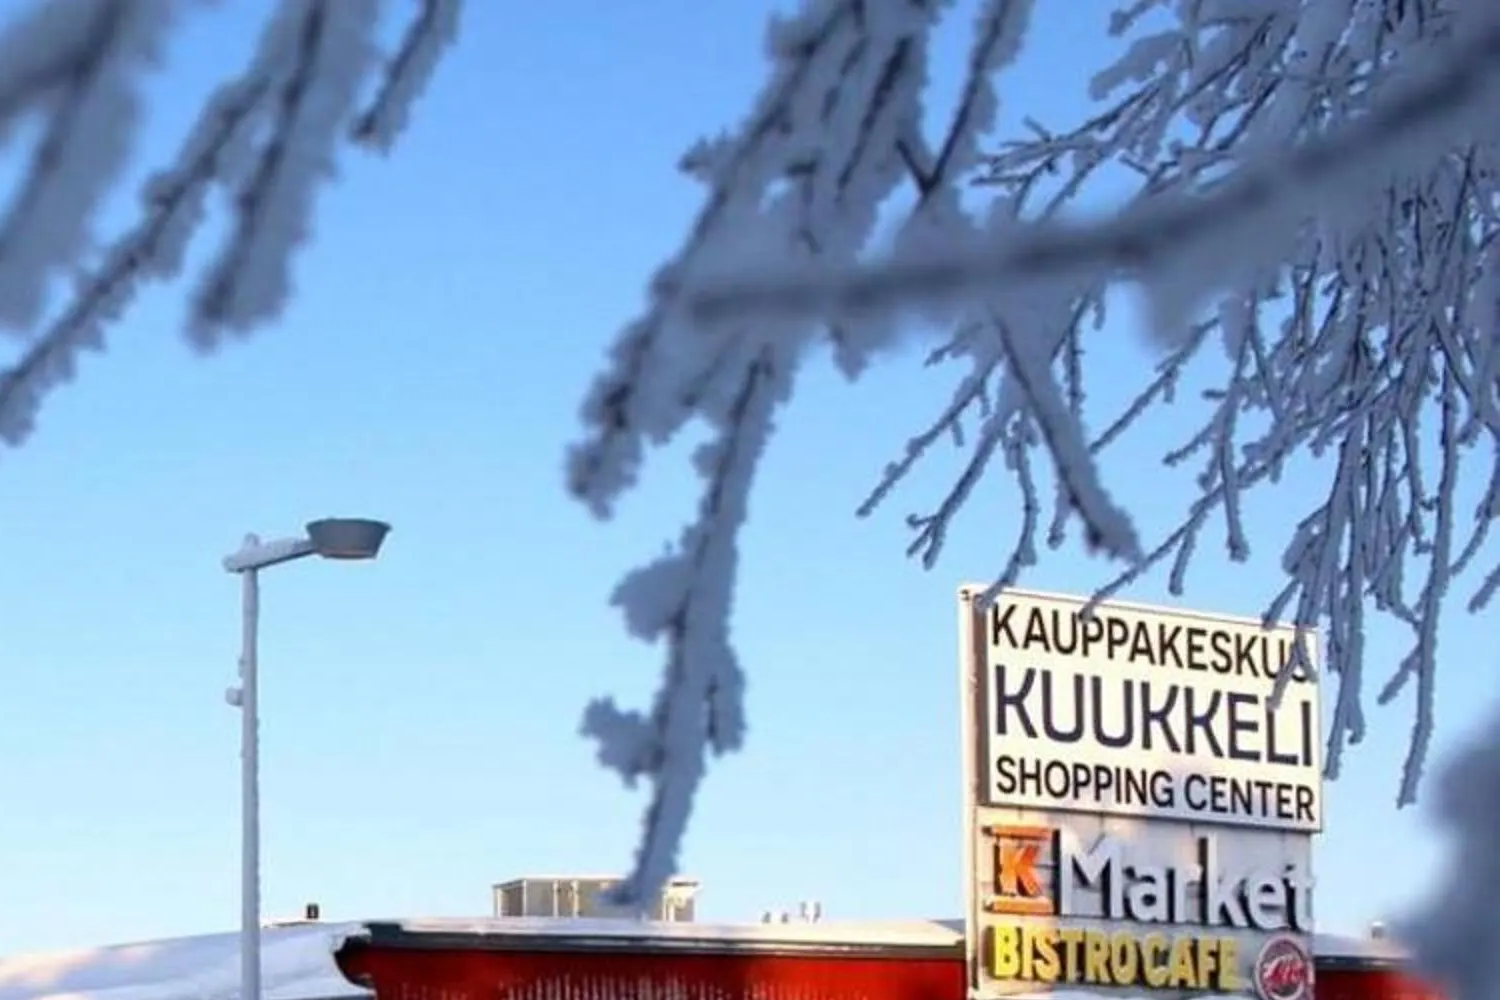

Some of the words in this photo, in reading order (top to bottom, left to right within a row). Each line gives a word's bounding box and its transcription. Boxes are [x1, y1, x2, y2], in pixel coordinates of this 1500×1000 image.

[996, 664, 1313, 767] KUUKKELI
[996, 754, 1176, 808] SHOPPING
[1184, 773, 1315, 822] CENTER
[1060, 828, 1315, 932] Market
